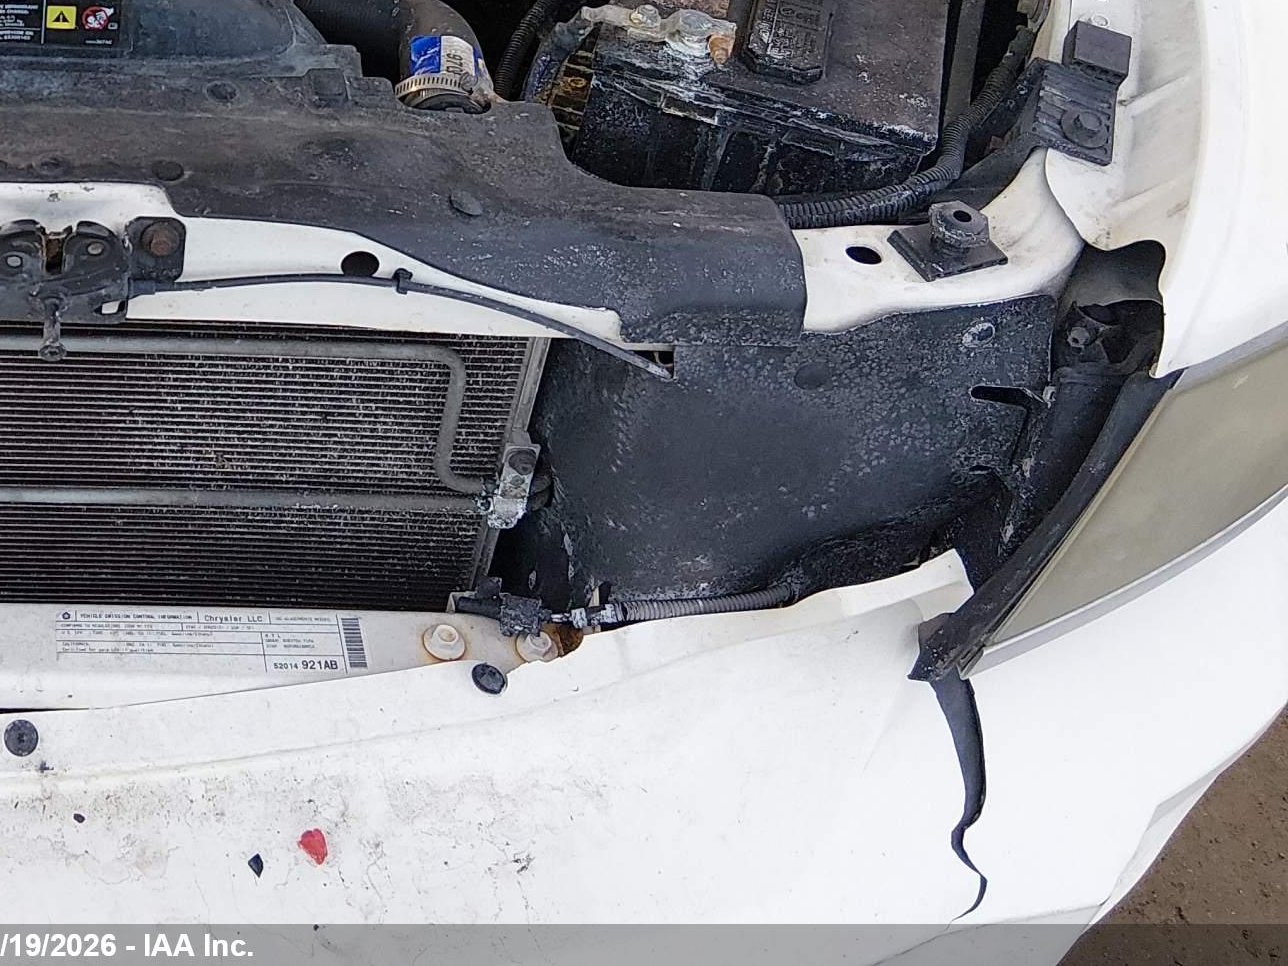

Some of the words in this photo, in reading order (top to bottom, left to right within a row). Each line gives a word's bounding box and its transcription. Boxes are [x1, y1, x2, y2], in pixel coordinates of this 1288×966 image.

[204, 614, 243, 624] Chrysler
[247, 615, 263, 623] LLC
[273, 662, 299, 671] 52014
[301, 659, 339, 671] 921AB
